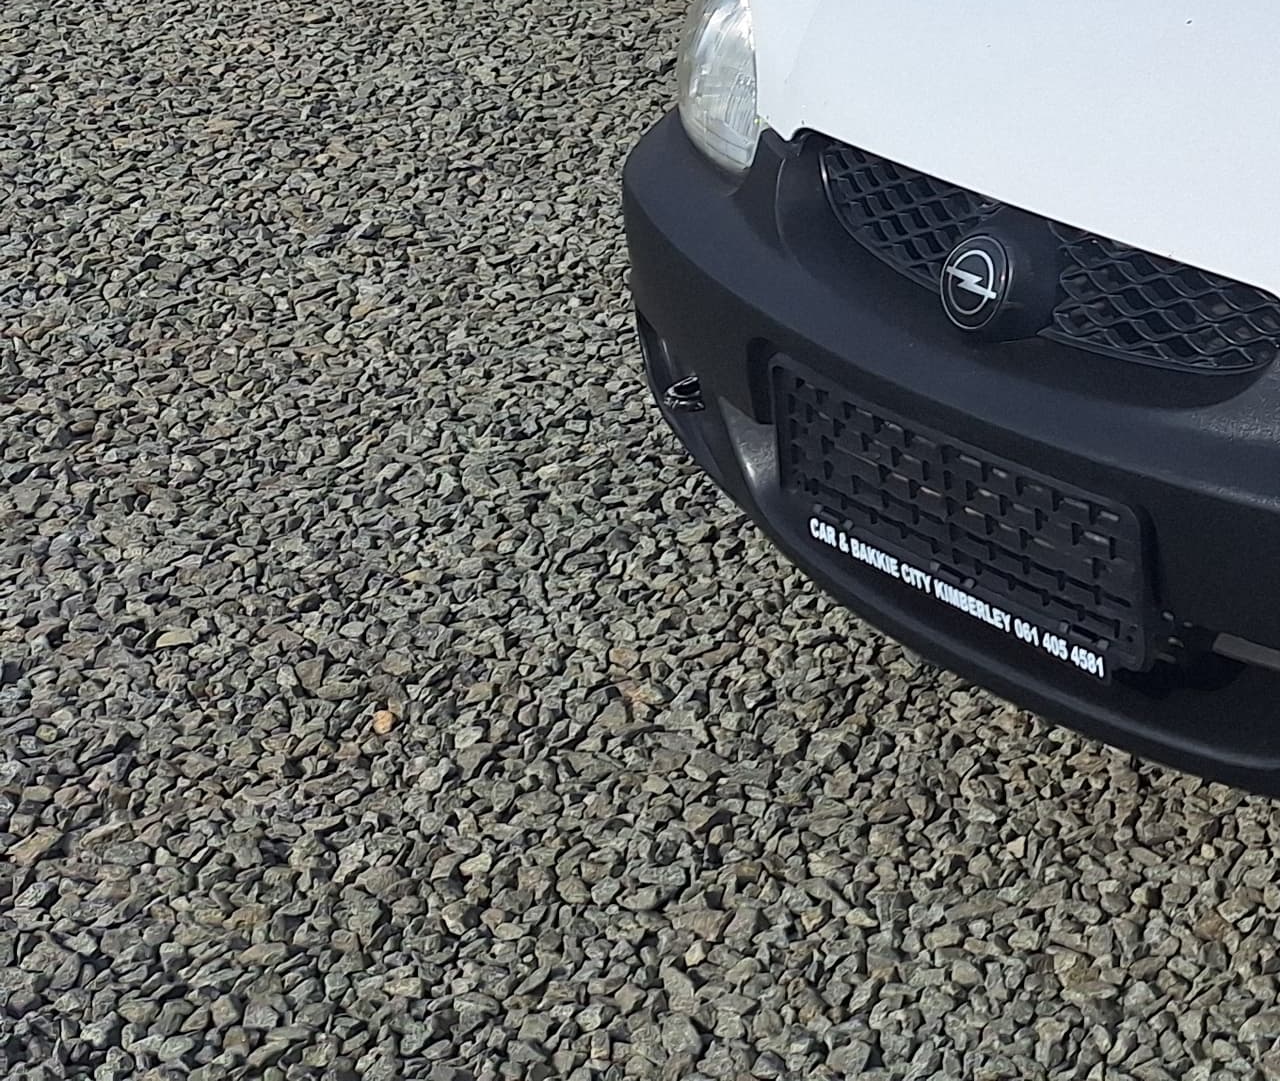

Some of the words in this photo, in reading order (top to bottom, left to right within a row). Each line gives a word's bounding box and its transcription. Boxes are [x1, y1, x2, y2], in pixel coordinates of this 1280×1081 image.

[810, 518, 837, 547] CAR
[838, 532, 850, 554] &
[850, 537, 900, 578] BAKKIE
[900, 563, 932, 594] CITY
[933, 578, 1012, 633] KIMBERLEY
[1014, 618, 1039, 647] 061
[1042, 632, 1068, 661] 405
[1070, 645, 1104, 678] 4581
